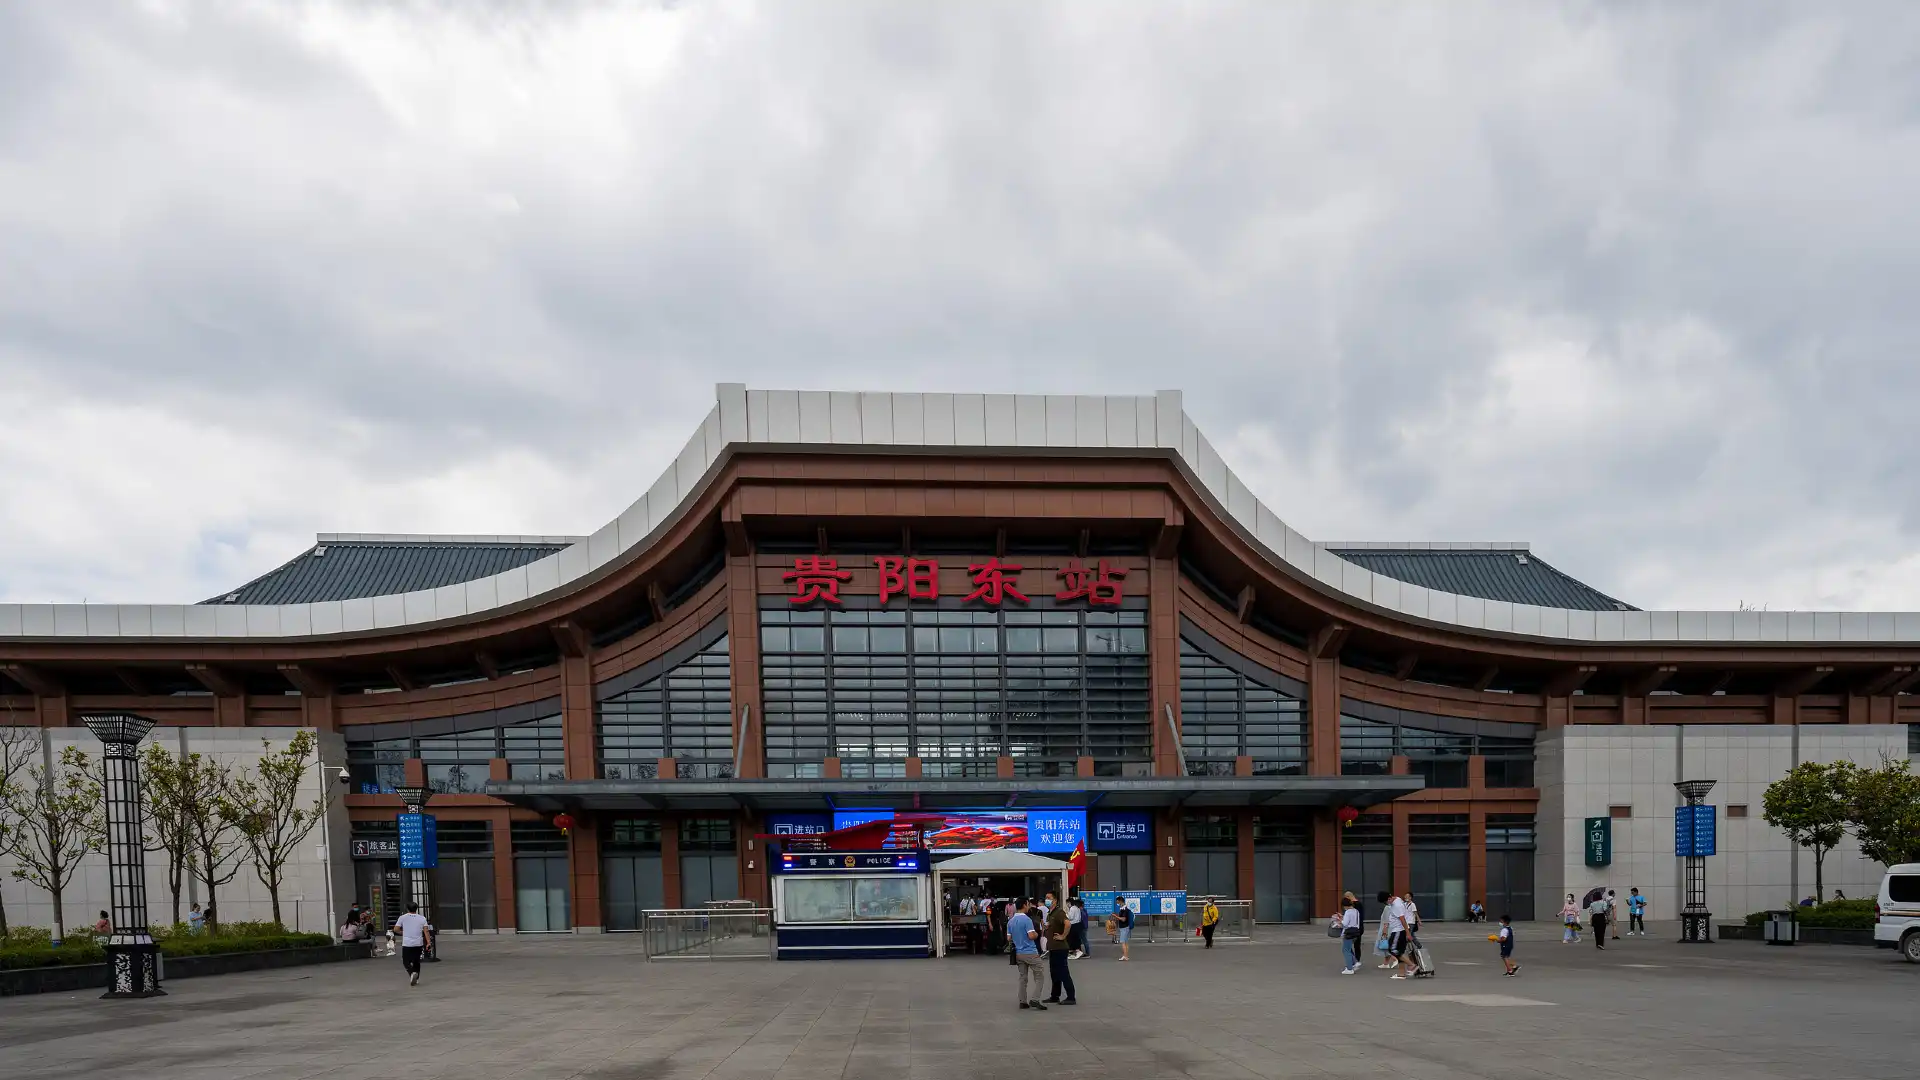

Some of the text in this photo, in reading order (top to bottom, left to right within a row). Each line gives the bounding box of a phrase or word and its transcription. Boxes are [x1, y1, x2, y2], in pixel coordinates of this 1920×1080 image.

[782, 555, 1130, 605] 贵阳东站
[794, 825, 825, 834] 进站口
[1034, 819, 1081, 830] 贵阳东站
[1116, 823, 1146, 833] 进站口
[1040, 833, 1075, 844] 欢迎您
[809, 858, 836, 866] 警察
